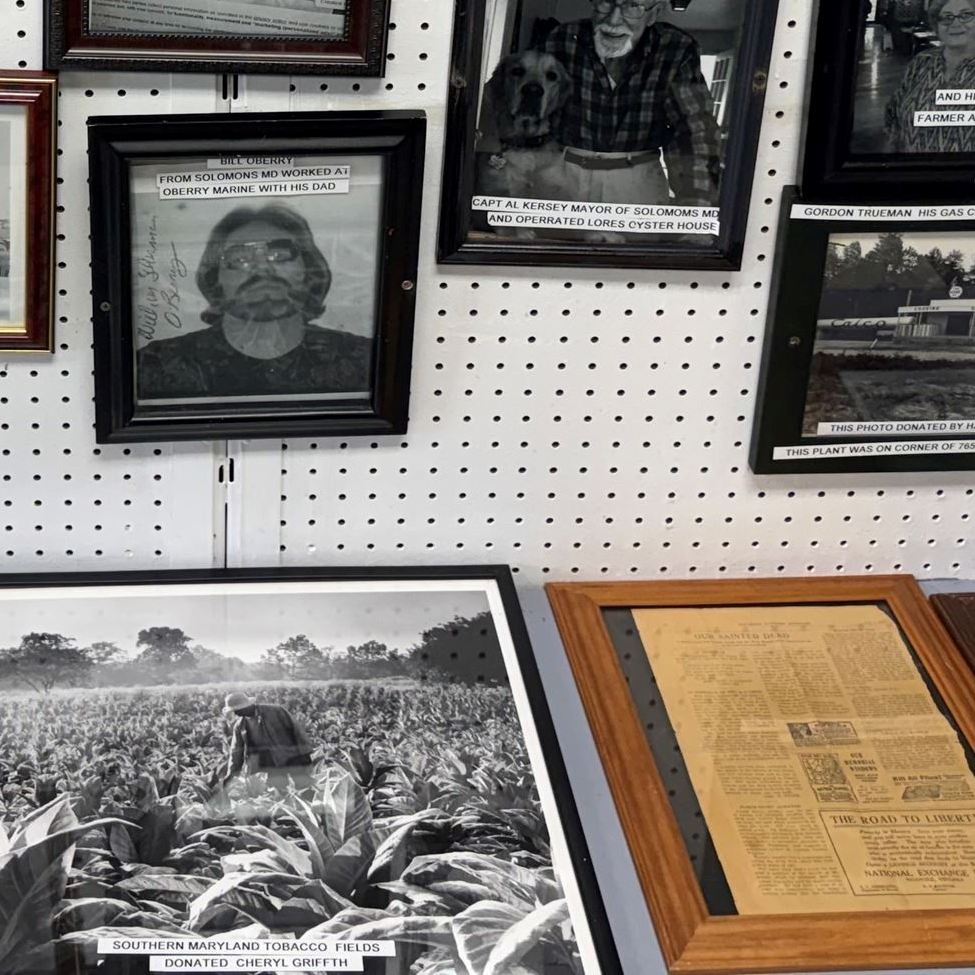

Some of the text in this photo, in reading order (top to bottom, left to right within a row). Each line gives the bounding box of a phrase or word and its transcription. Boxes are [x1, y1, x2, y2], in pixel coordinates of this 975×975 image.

[937, 92, 961, 101] AND
[917, 113, 965, 123] FARMER
[246, 157, 293, 165] OBERRY
[159, 175, 192, 184] FROM
[195, 172, 258, 182] SOLOMONS
[261, 170, 279, 179] MD
[281, 168, 331, 178] WORKED
[472, 198, 501, 208] CAPT
[505, 200, 519, 209] AL
[523, 201, 569, 212] KERSEY
[571, 204, 612, 215] MAYOR
[615, 205, 630, 215] OF
[702, 209, 719, 218] MD
[804, 207, 854, 217] GORDON
[858, 208, 912, 217] TRUEMAN
[918, 208, 936, 217] HIS
[940, 208, 964, 217] GAS
[786, 448, 810, 456] THIS
[812, 446, 847, 456] PLANT
[849, 445, 873, 454] WAS
[876, 444, 892, 453] ON
[895, 443, 938, 452] CORNER
[941, 442, 955, 451] OF
[829, 815, 856, 824] THE
[860, 815, 897, 825] ROAD
[901, 815, 920, 823] TO
[113, 940, 381, 953] SOUTHERN MARYLAND TOBACCO FIELDS
[165, 957, 228, 969] DONATED
[236, 958, 289, 968] CHERYL
